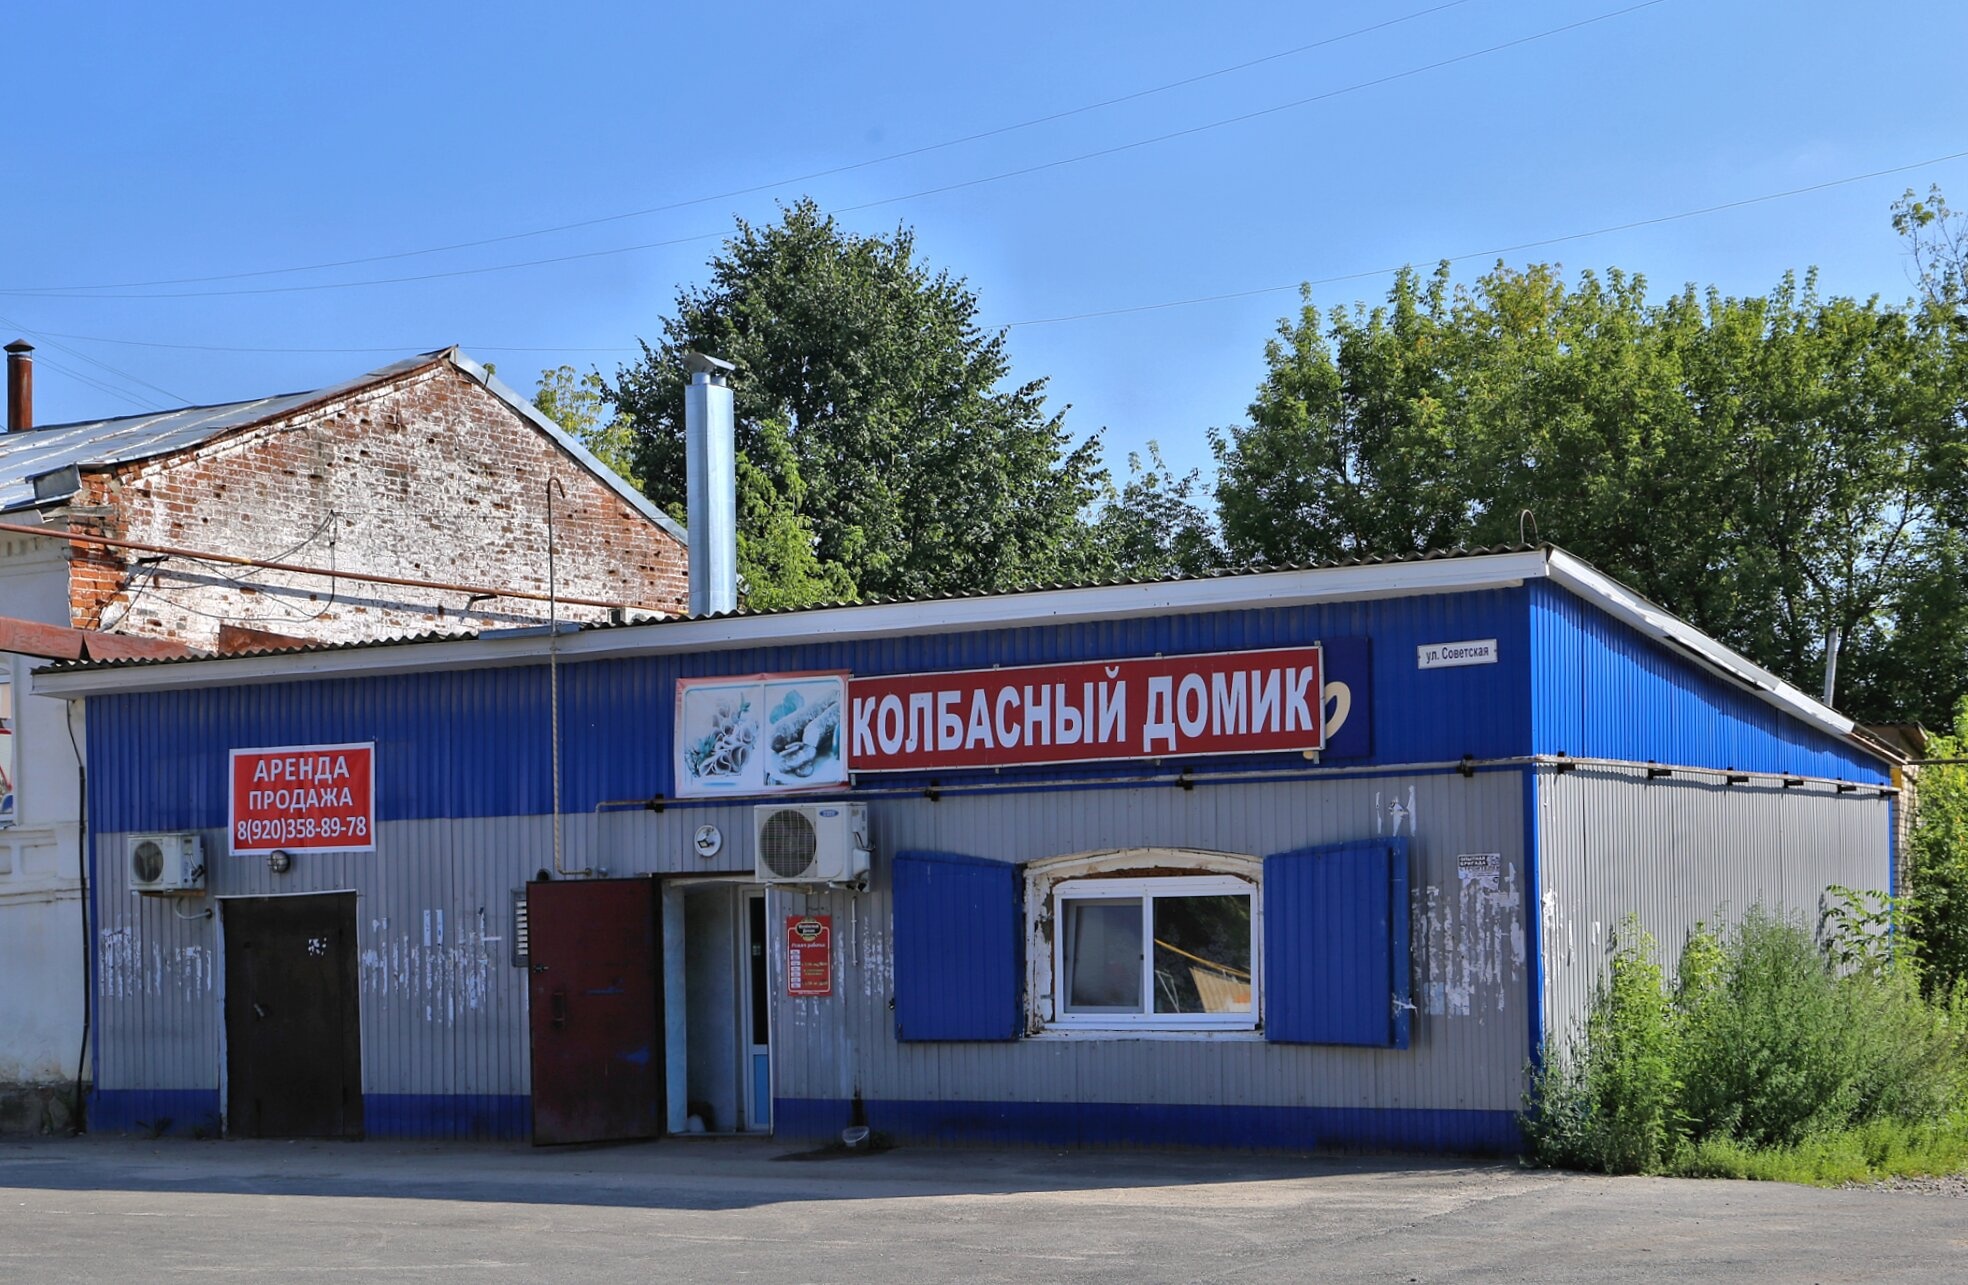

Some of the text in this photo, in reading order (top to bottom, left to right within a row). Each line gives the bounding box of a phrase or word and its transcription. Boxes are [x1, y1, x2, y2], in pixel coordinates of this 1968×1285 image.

[1426, 646, 1489, 664] ул. Советская
[853, 666, 1127, 757] КОЛБАСНЫЙ
[1143, 666, 1314, 753] ДОМИК
[253, 755, 350, 785] АРЕНДА
[249, 787, 353, 813] ПРОДАЖА
[237, 816, 367, 844] 8(920)358-89-78
